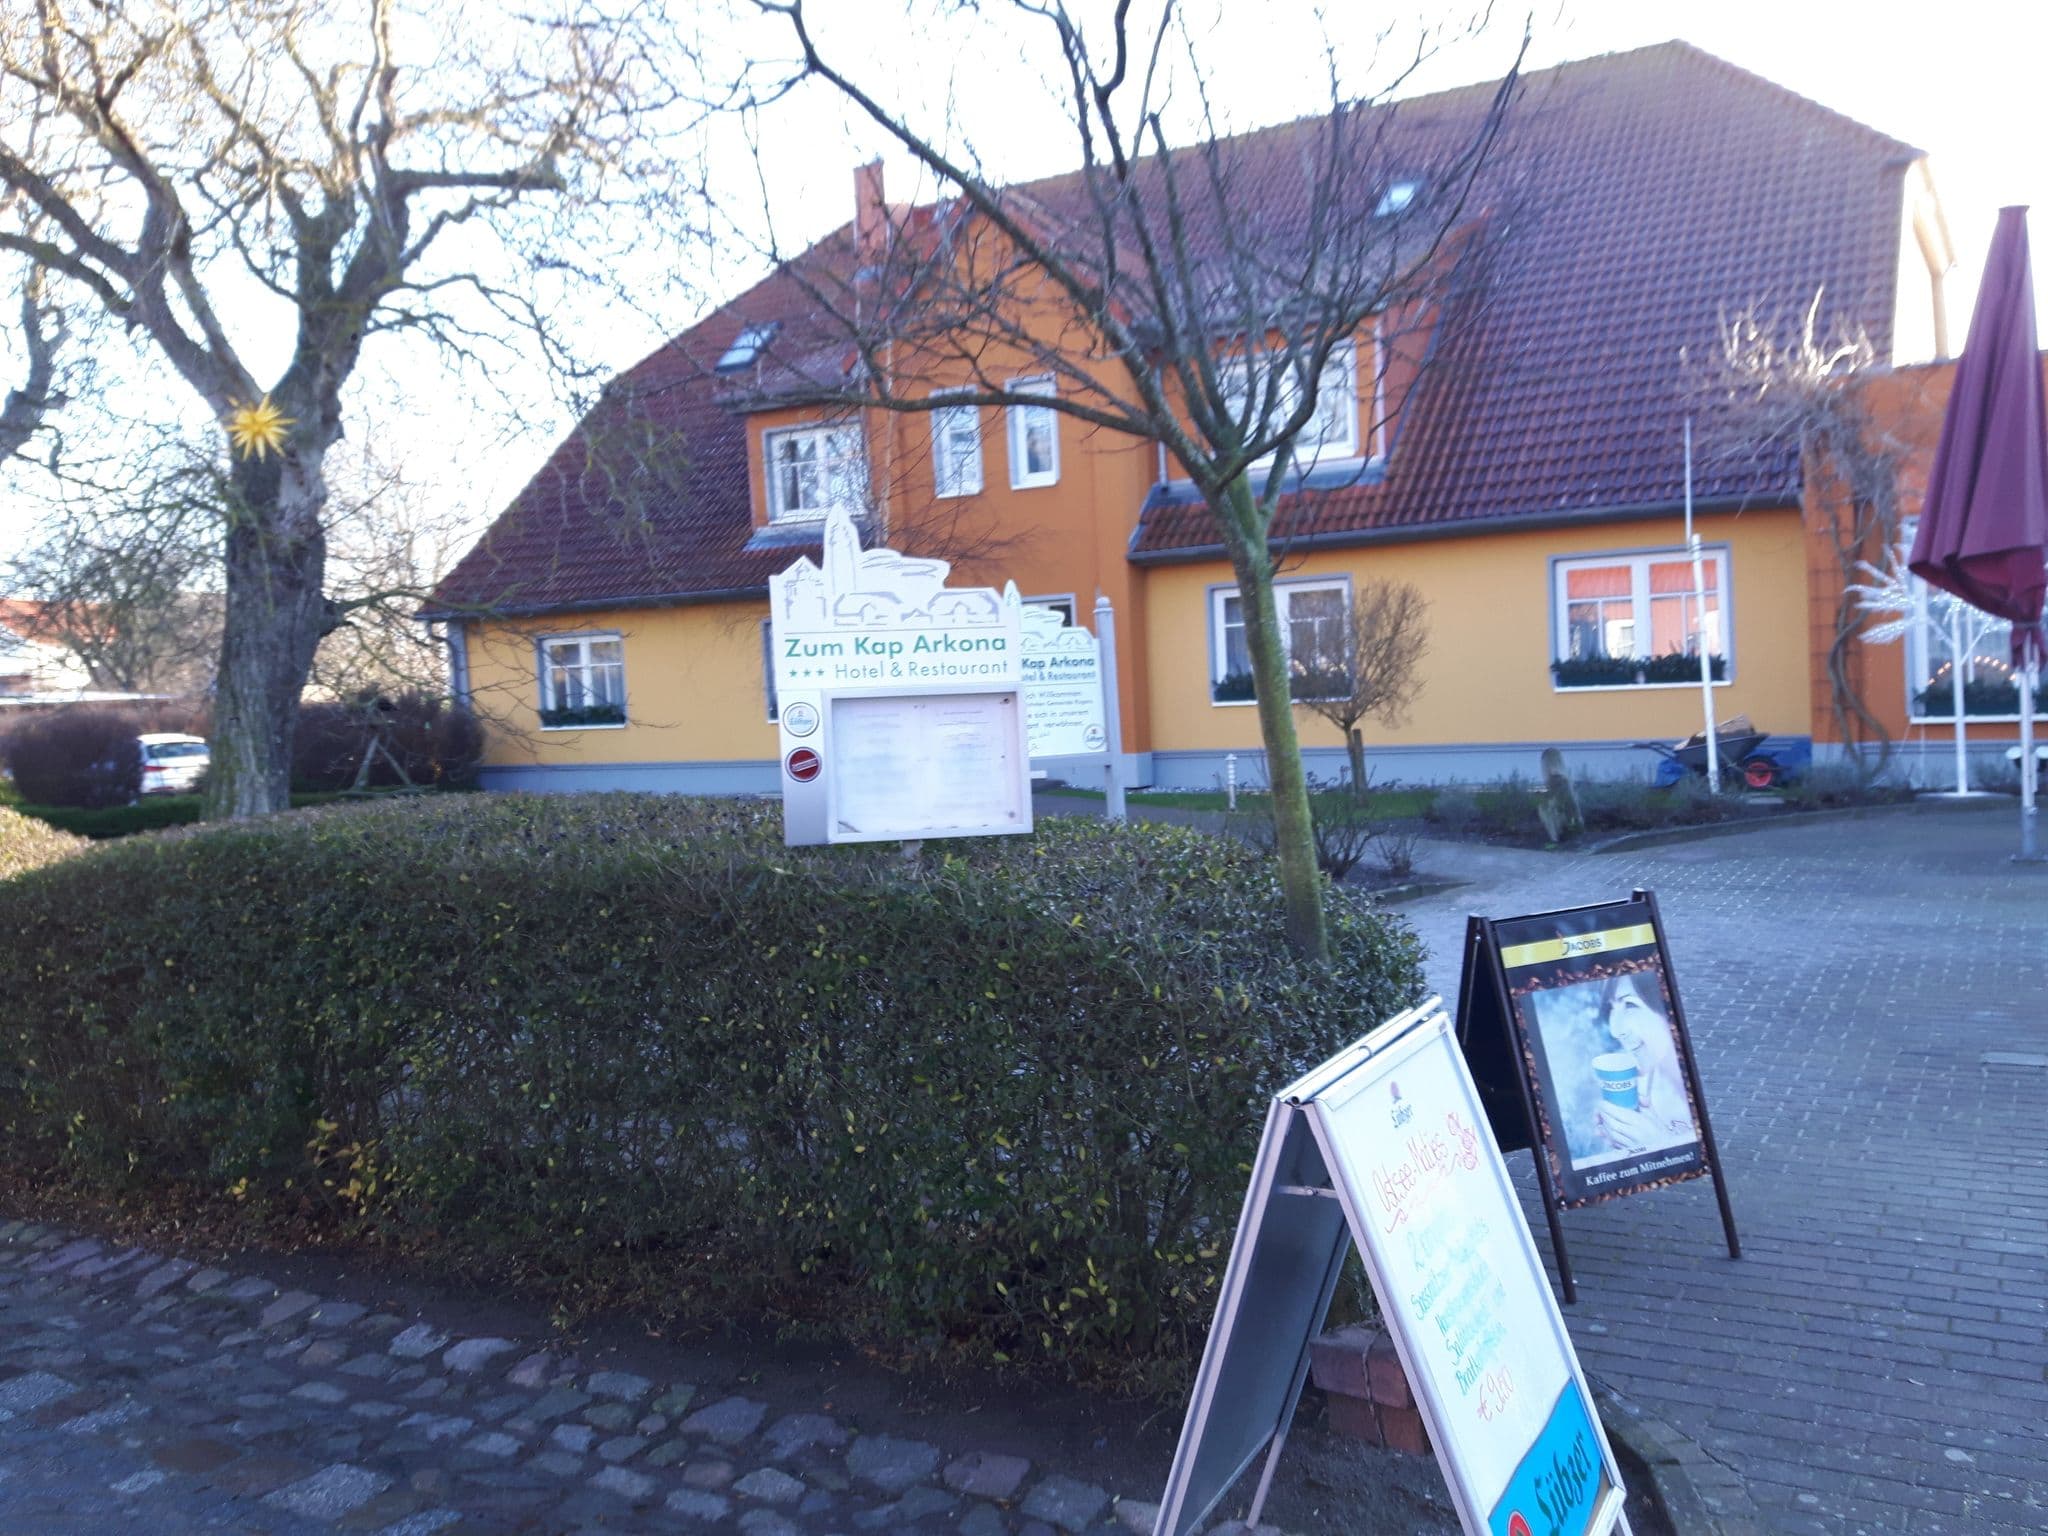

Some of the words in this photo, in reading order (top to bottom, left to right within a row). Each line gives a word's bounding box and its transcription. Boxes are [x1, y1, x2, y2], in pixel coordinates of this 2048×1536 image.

[784, 638, 843, 658] Zum
[854, 636, 903, 659] Kap
[912, 633, 1007, 654] Arkona
[834, 660, 885, 680] Hotel
[889, 661, 904, 678] &
[908, 659, 1008, 677] Restaurant
[1021, 658, 1046, 670] Kap
[1050, 656, 1096, 668] Arkona
[1048, 670, 1097, 681] Restaurant
[1562, 938, 1602, 956] JACOBS
[1603, 1081, 1632, 1090] JACOBS
[1585, 1172, 1618, 1187] Kaffee
[1619, 1166, 1640, 1179] zum
[1639, 1151, 1696, 1175] Mitnehmen!
[1533, 1428, 1592, 1536] Lübzer
